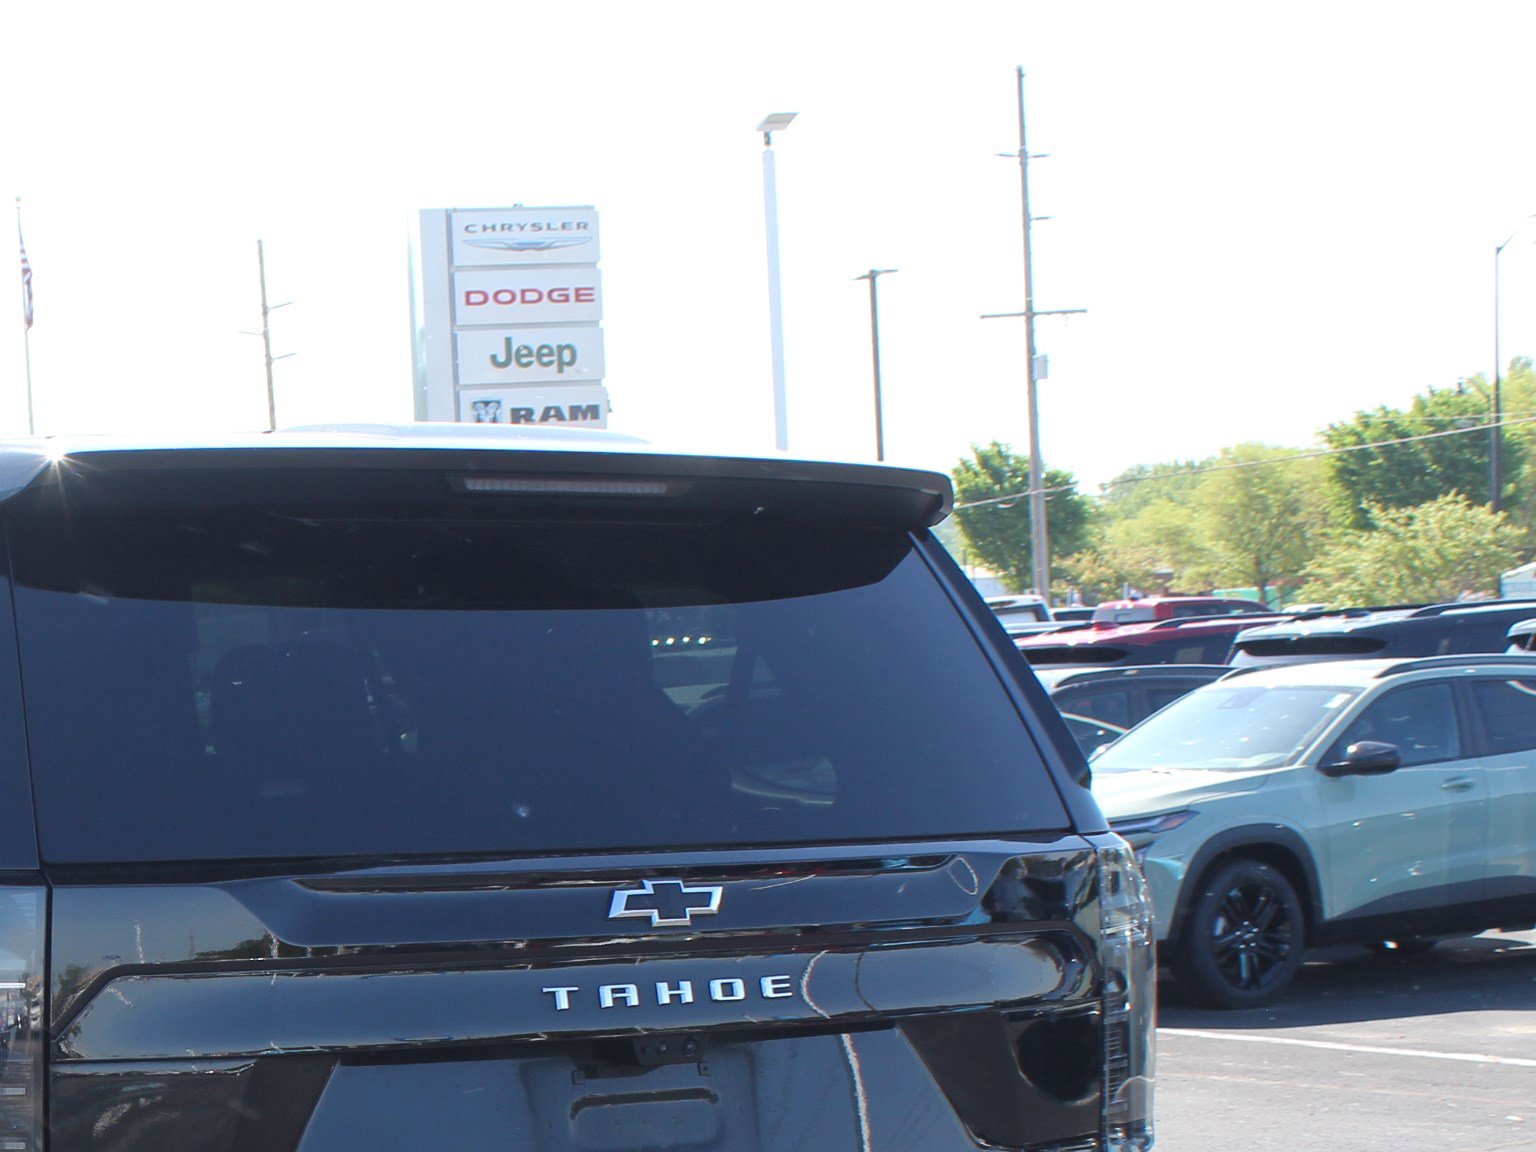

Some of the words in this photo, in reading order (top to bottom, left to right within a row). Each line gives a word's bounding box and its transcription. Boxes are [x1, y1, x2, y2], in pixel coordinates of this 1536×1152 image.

[464, 221, 590, 233] CHRYSLER
[464, 287, 596, 306] DODGE
[490, 336, 578, 374] Jeep
[510, 404, 601, 424] RAM
[542, 975, 793, 1010] TAHOE
